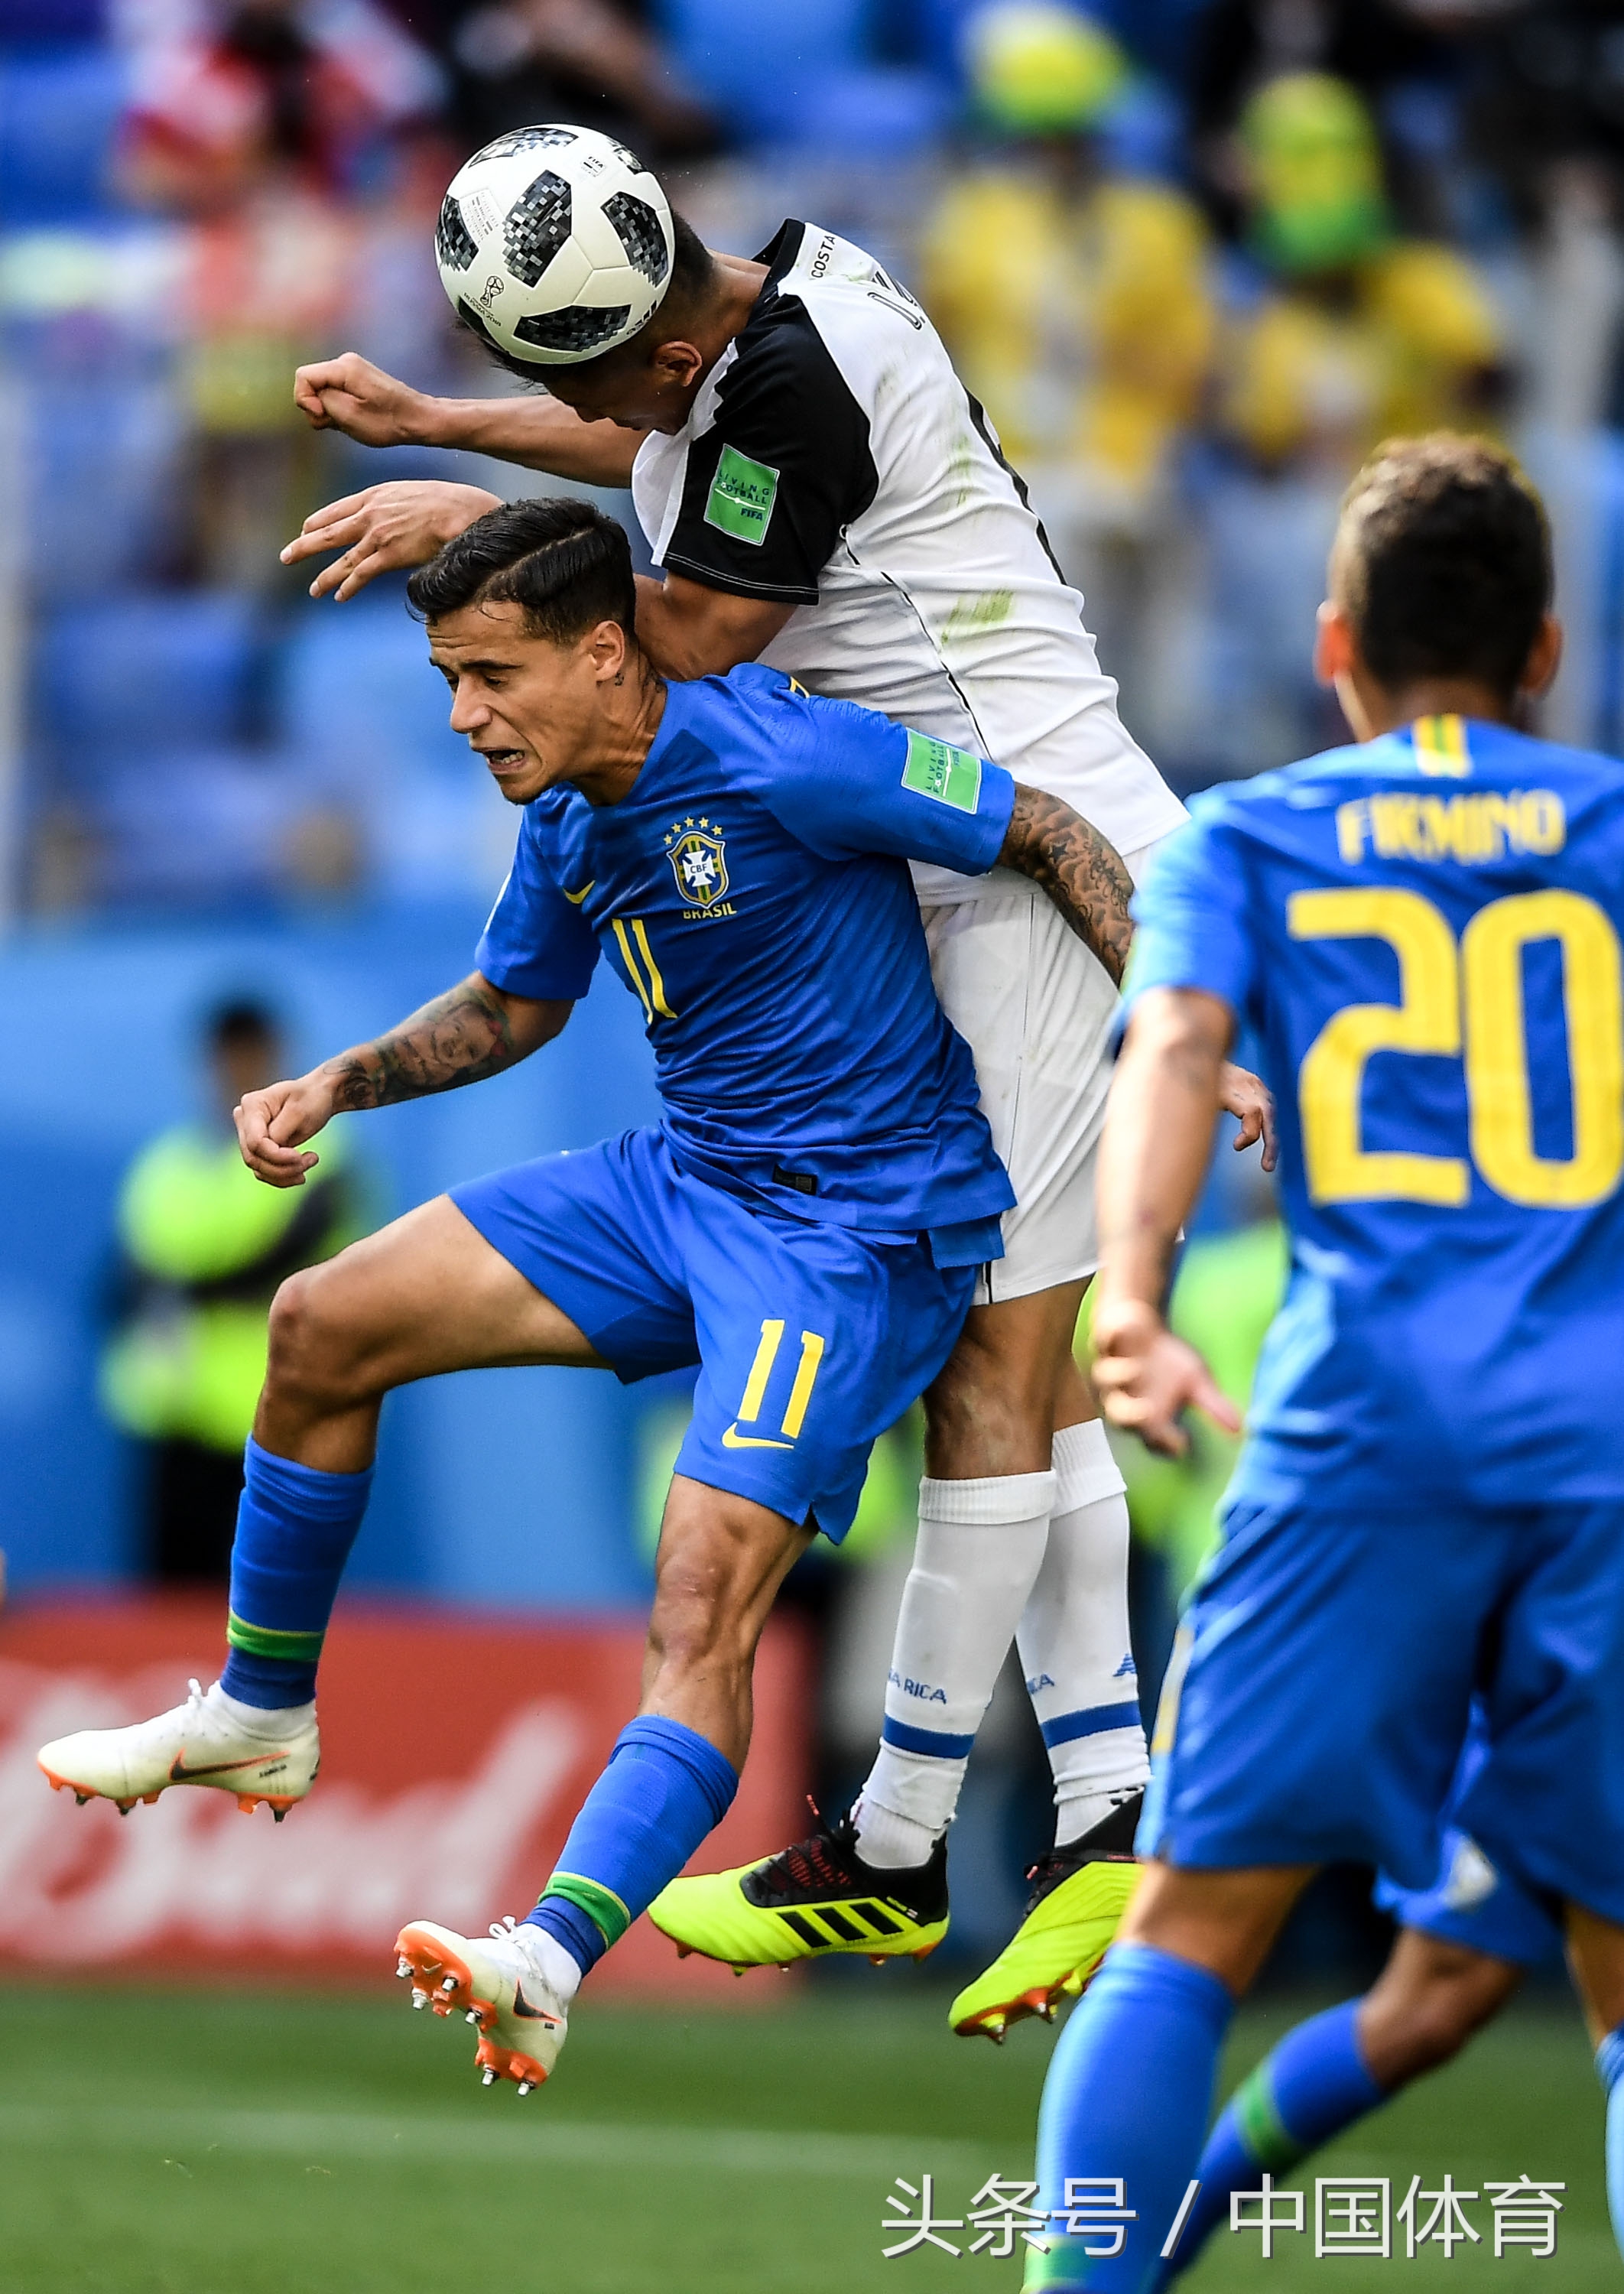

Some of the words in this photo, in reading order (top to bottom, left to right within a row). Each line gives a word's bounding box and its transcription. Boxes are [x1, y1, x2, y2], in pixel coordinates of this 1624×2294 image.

[810, 235, 836, 279] COSTA
[719, 469, 770, 496] LIVING
[740, 508, 764, 522] FIFA
[1337, 788, 1567, 866] FIRMINO
[690, 863, 708, 874] CBF
[683, 902, 738, 920] BRASIL
[612, 918, 679, 1025] 11
[1285, 885, 1624, 1210] 20
[736, 1318, 826, 1440] 11
[904, 1678, 947, 1705] RICA
